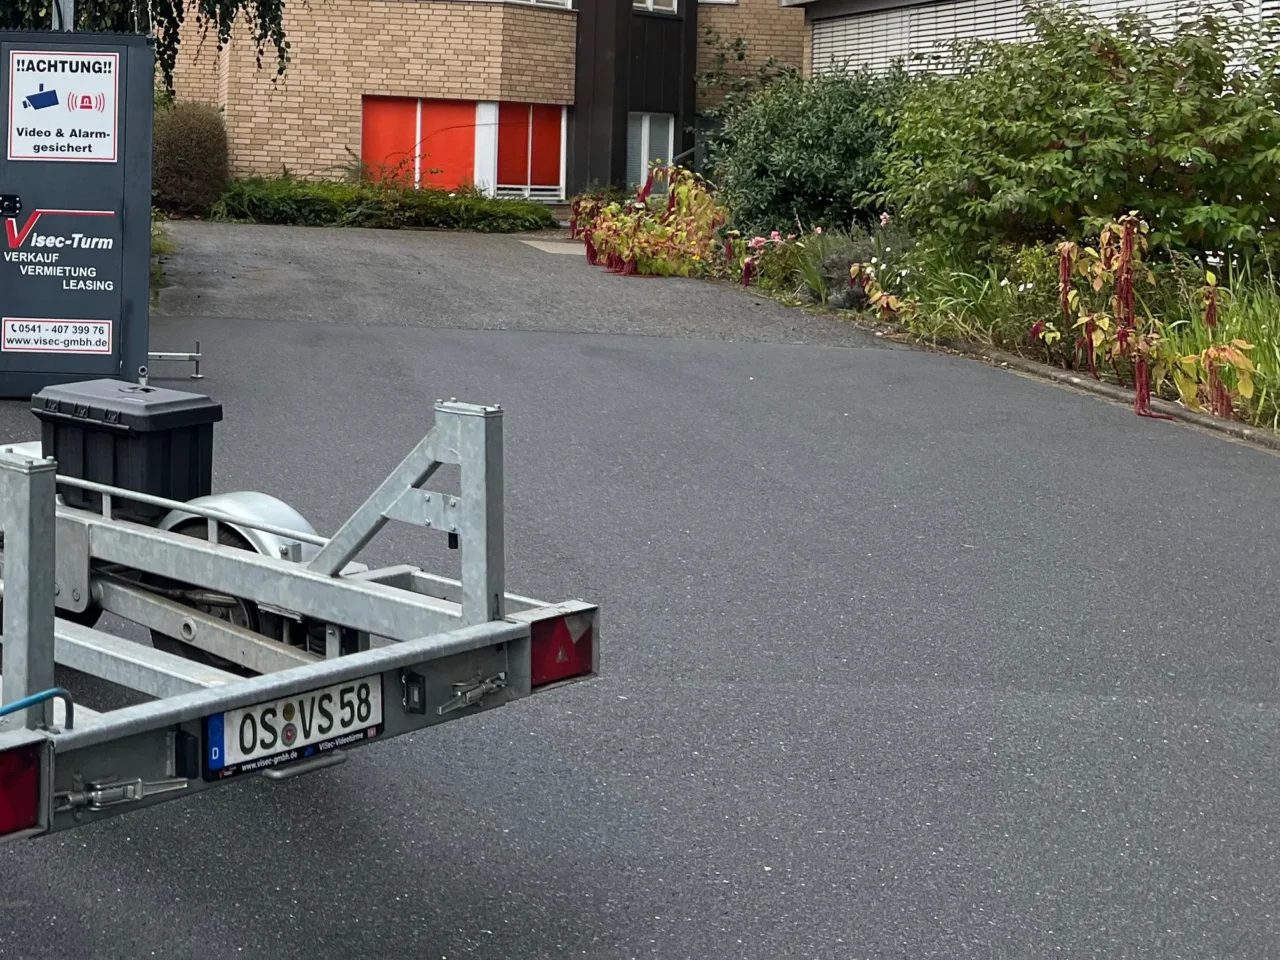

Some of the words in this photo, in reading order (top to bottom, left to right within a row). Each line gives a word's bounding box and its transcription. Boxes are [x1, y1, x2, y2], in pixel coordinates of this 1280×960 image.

[16, 59, 112, 74] !!ACHTUNG!!
[16, 127, 51, 138] Video
[55, 128, 65, 138] &
[69, 128, 111, 139] Alarm-
[33, 143, 93, 154] gesichert
[4, 252, 60, 263] VERKAUF
[20, 265, 97, 277] VERMIETUNG
[62, 280, 114, 291] LEASING
[18, 324, 42, 333] 0541
[51, 325, 69, 334] 407
[72, 325, 90, 335] 399
[93, 326, 105, 335] 76
[6, 336, 108, 348] www.visec-gmbh.de
[239, 707, 278, 755] OS
[211, 747, 219, 760] D
[241, 750, 298, 771] www.visec-gmbh.de
